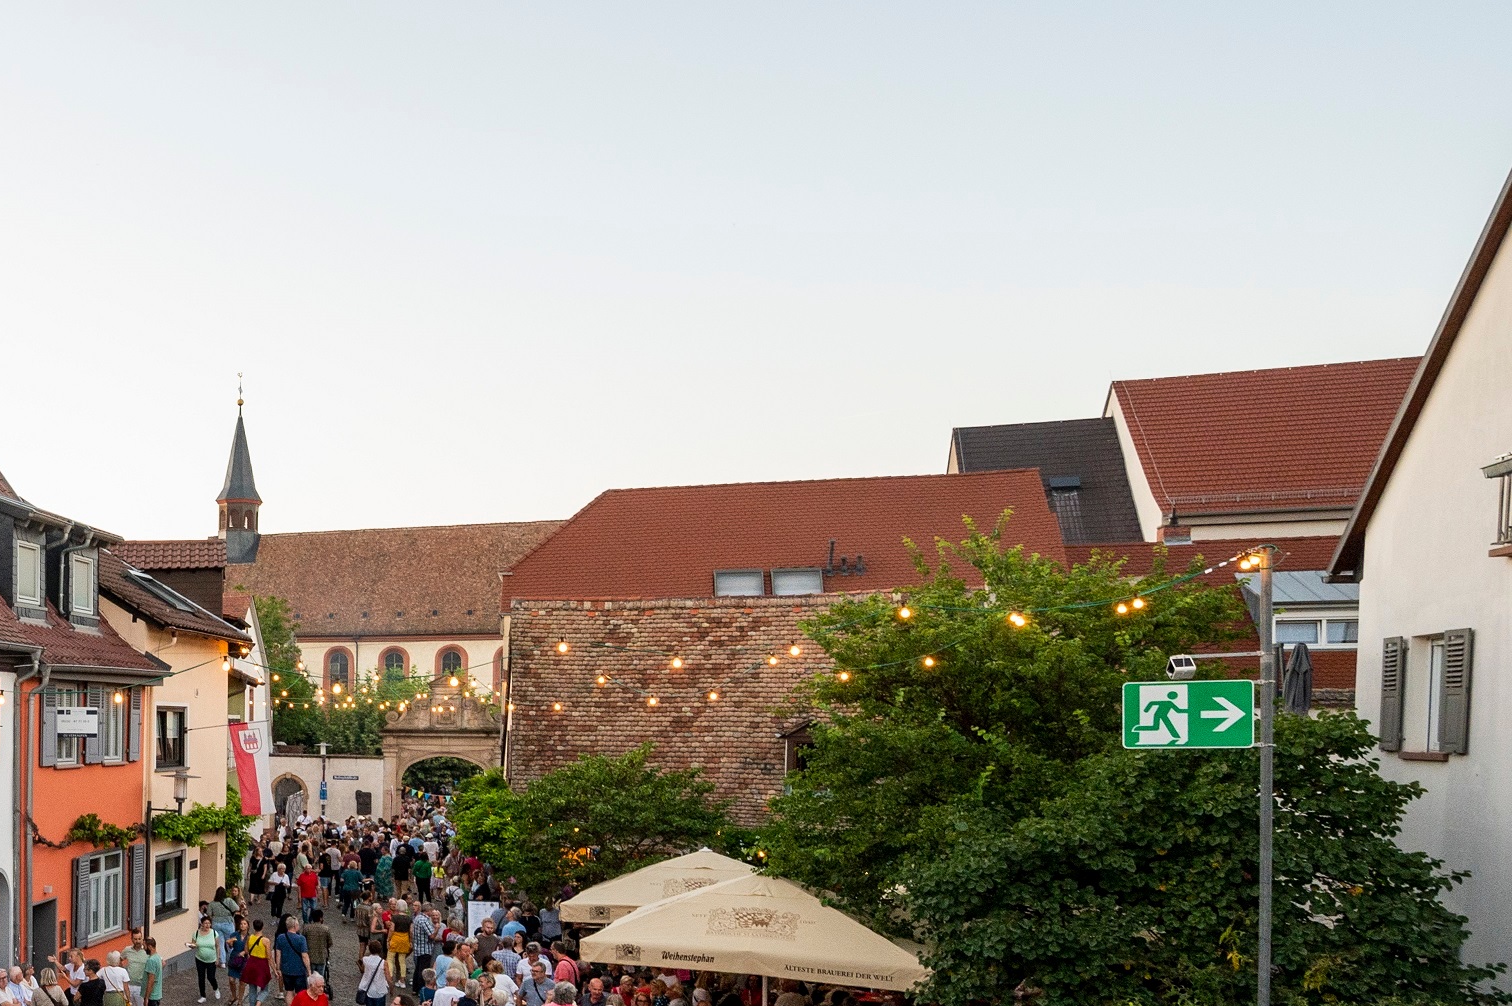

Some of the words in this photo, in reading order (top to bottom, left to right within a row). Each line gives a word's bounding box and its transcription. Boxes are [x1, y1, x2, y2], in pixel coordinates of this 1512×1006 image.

[661, 950, 715, 964] Weihenstephan
[816, 967, 854, 978] BRAUEREI
[855, 971, 872, 980] DER
[873, 973, 895, 982] WELT
